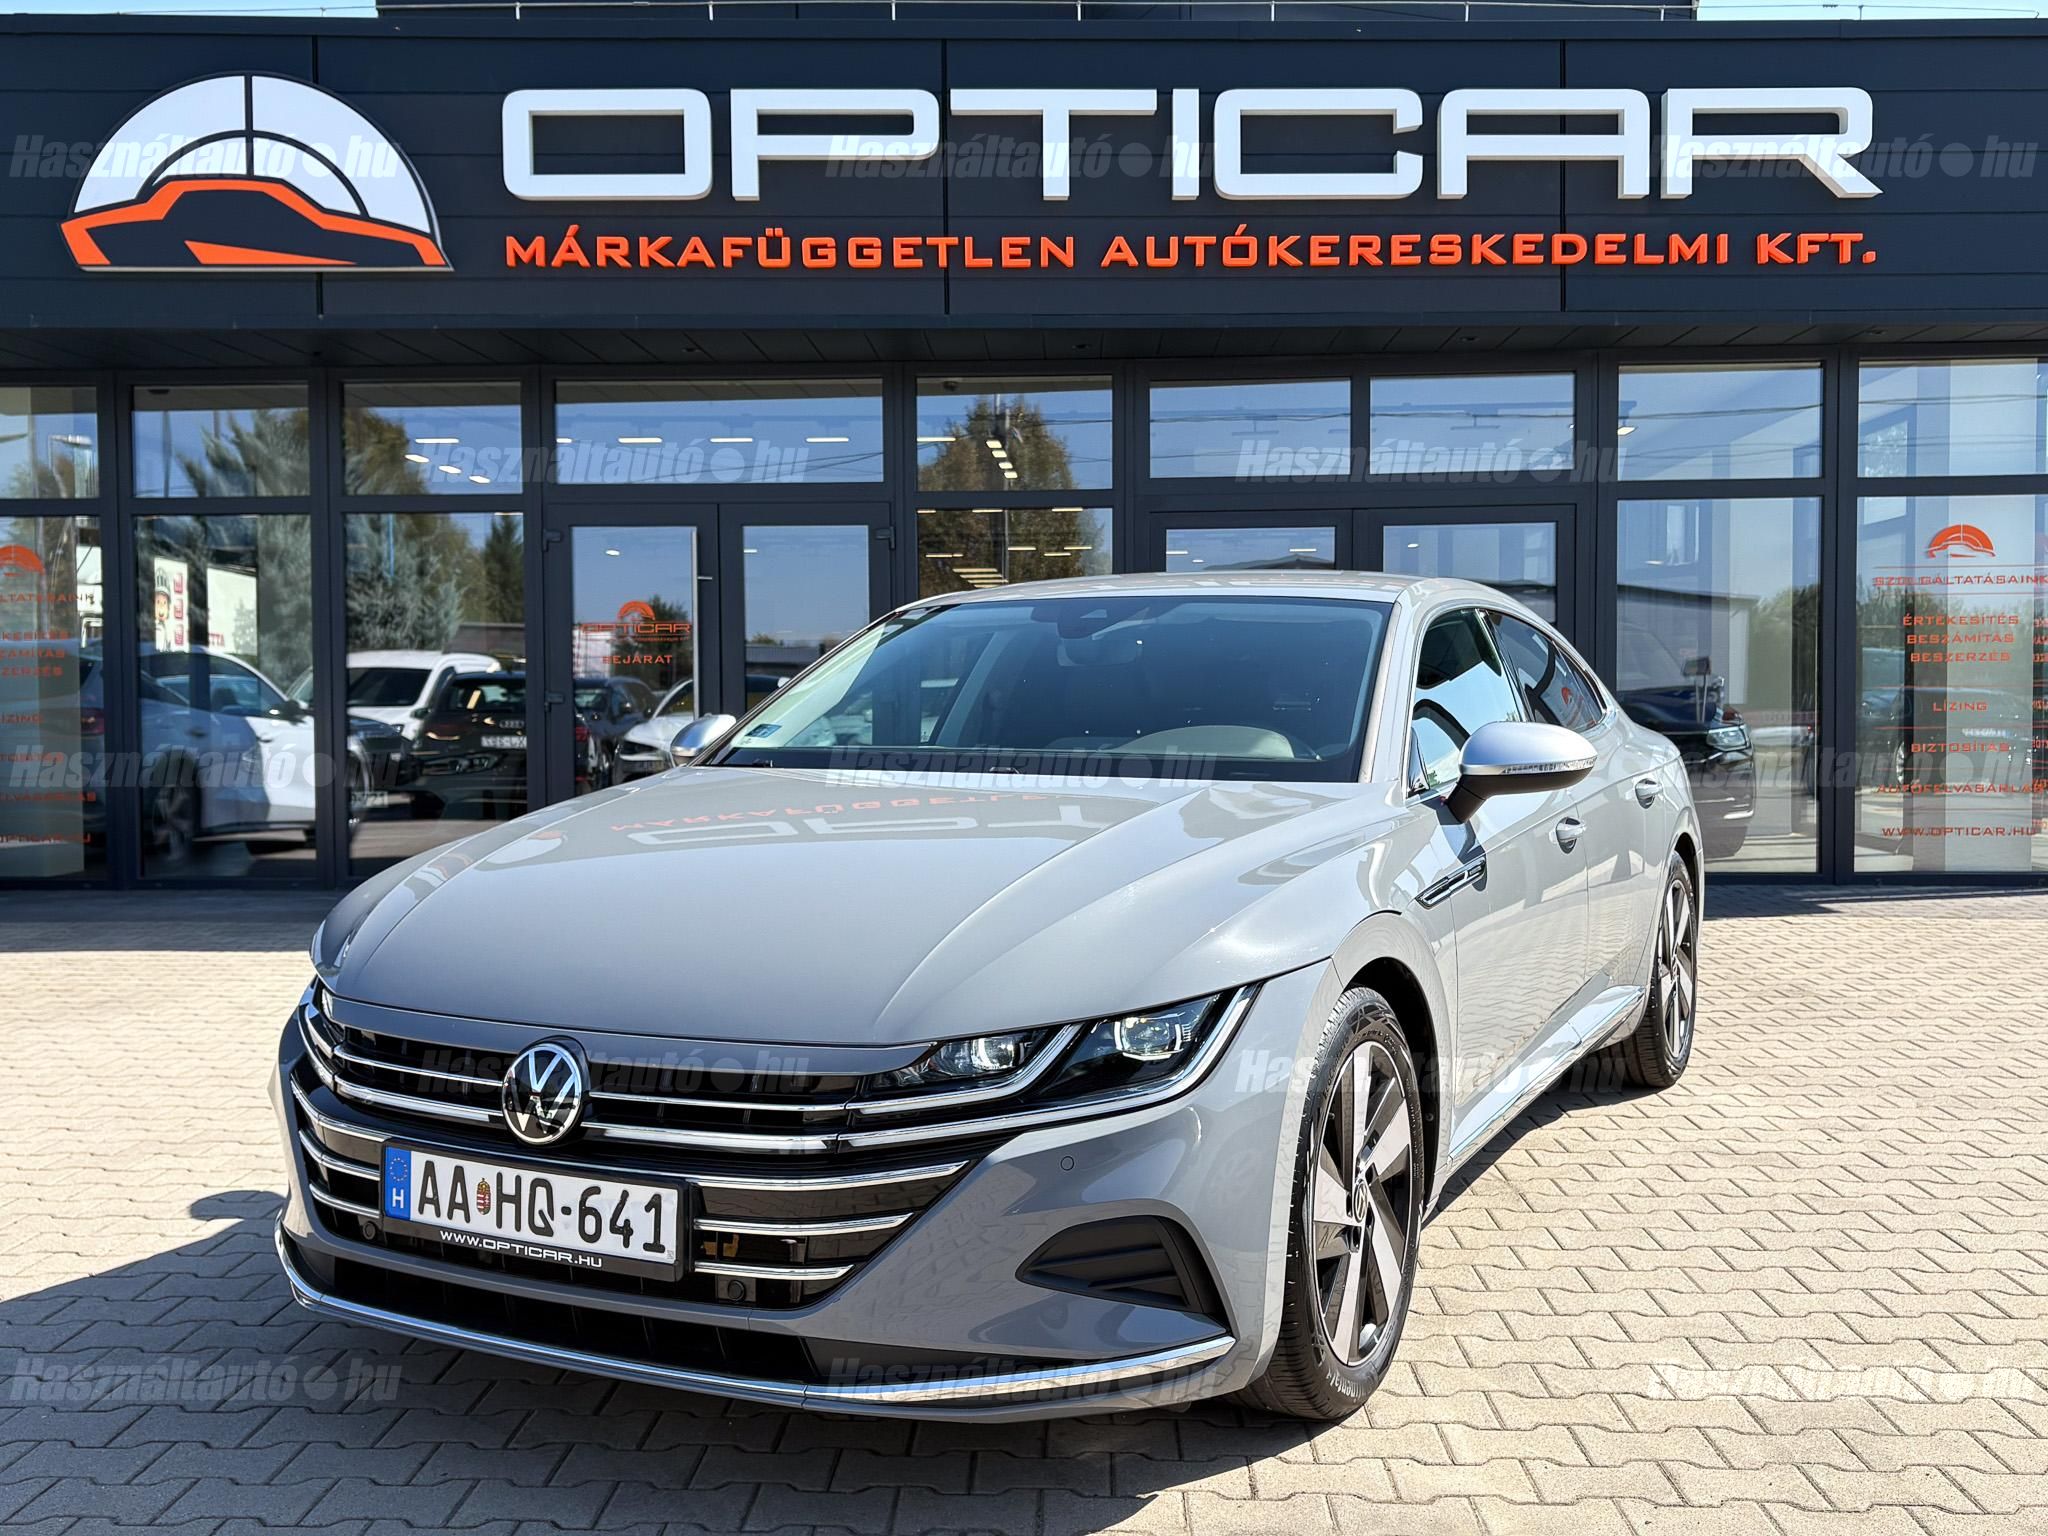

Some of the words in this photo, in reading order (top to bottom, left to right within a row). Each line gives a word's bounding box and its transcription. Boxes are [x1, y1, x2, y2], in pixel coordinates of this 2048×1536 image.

[502, 87, 1884, 202] OPTICAR
[505, 225, 1075, 270] MÁRKAFÜGGETLEN
[1101, 223, 1729, 269] AUTÓKERESKEDELMI
[1757, 231, 1878, 266] KFT.
[581, 622, 692, 634] OPTICAR
[603, 651, 673, 665] BEJÁRAT
[391, 1187, 405, 1209] H
[439, 1230, 603, 1268] WWW.OPTICAR.HU
